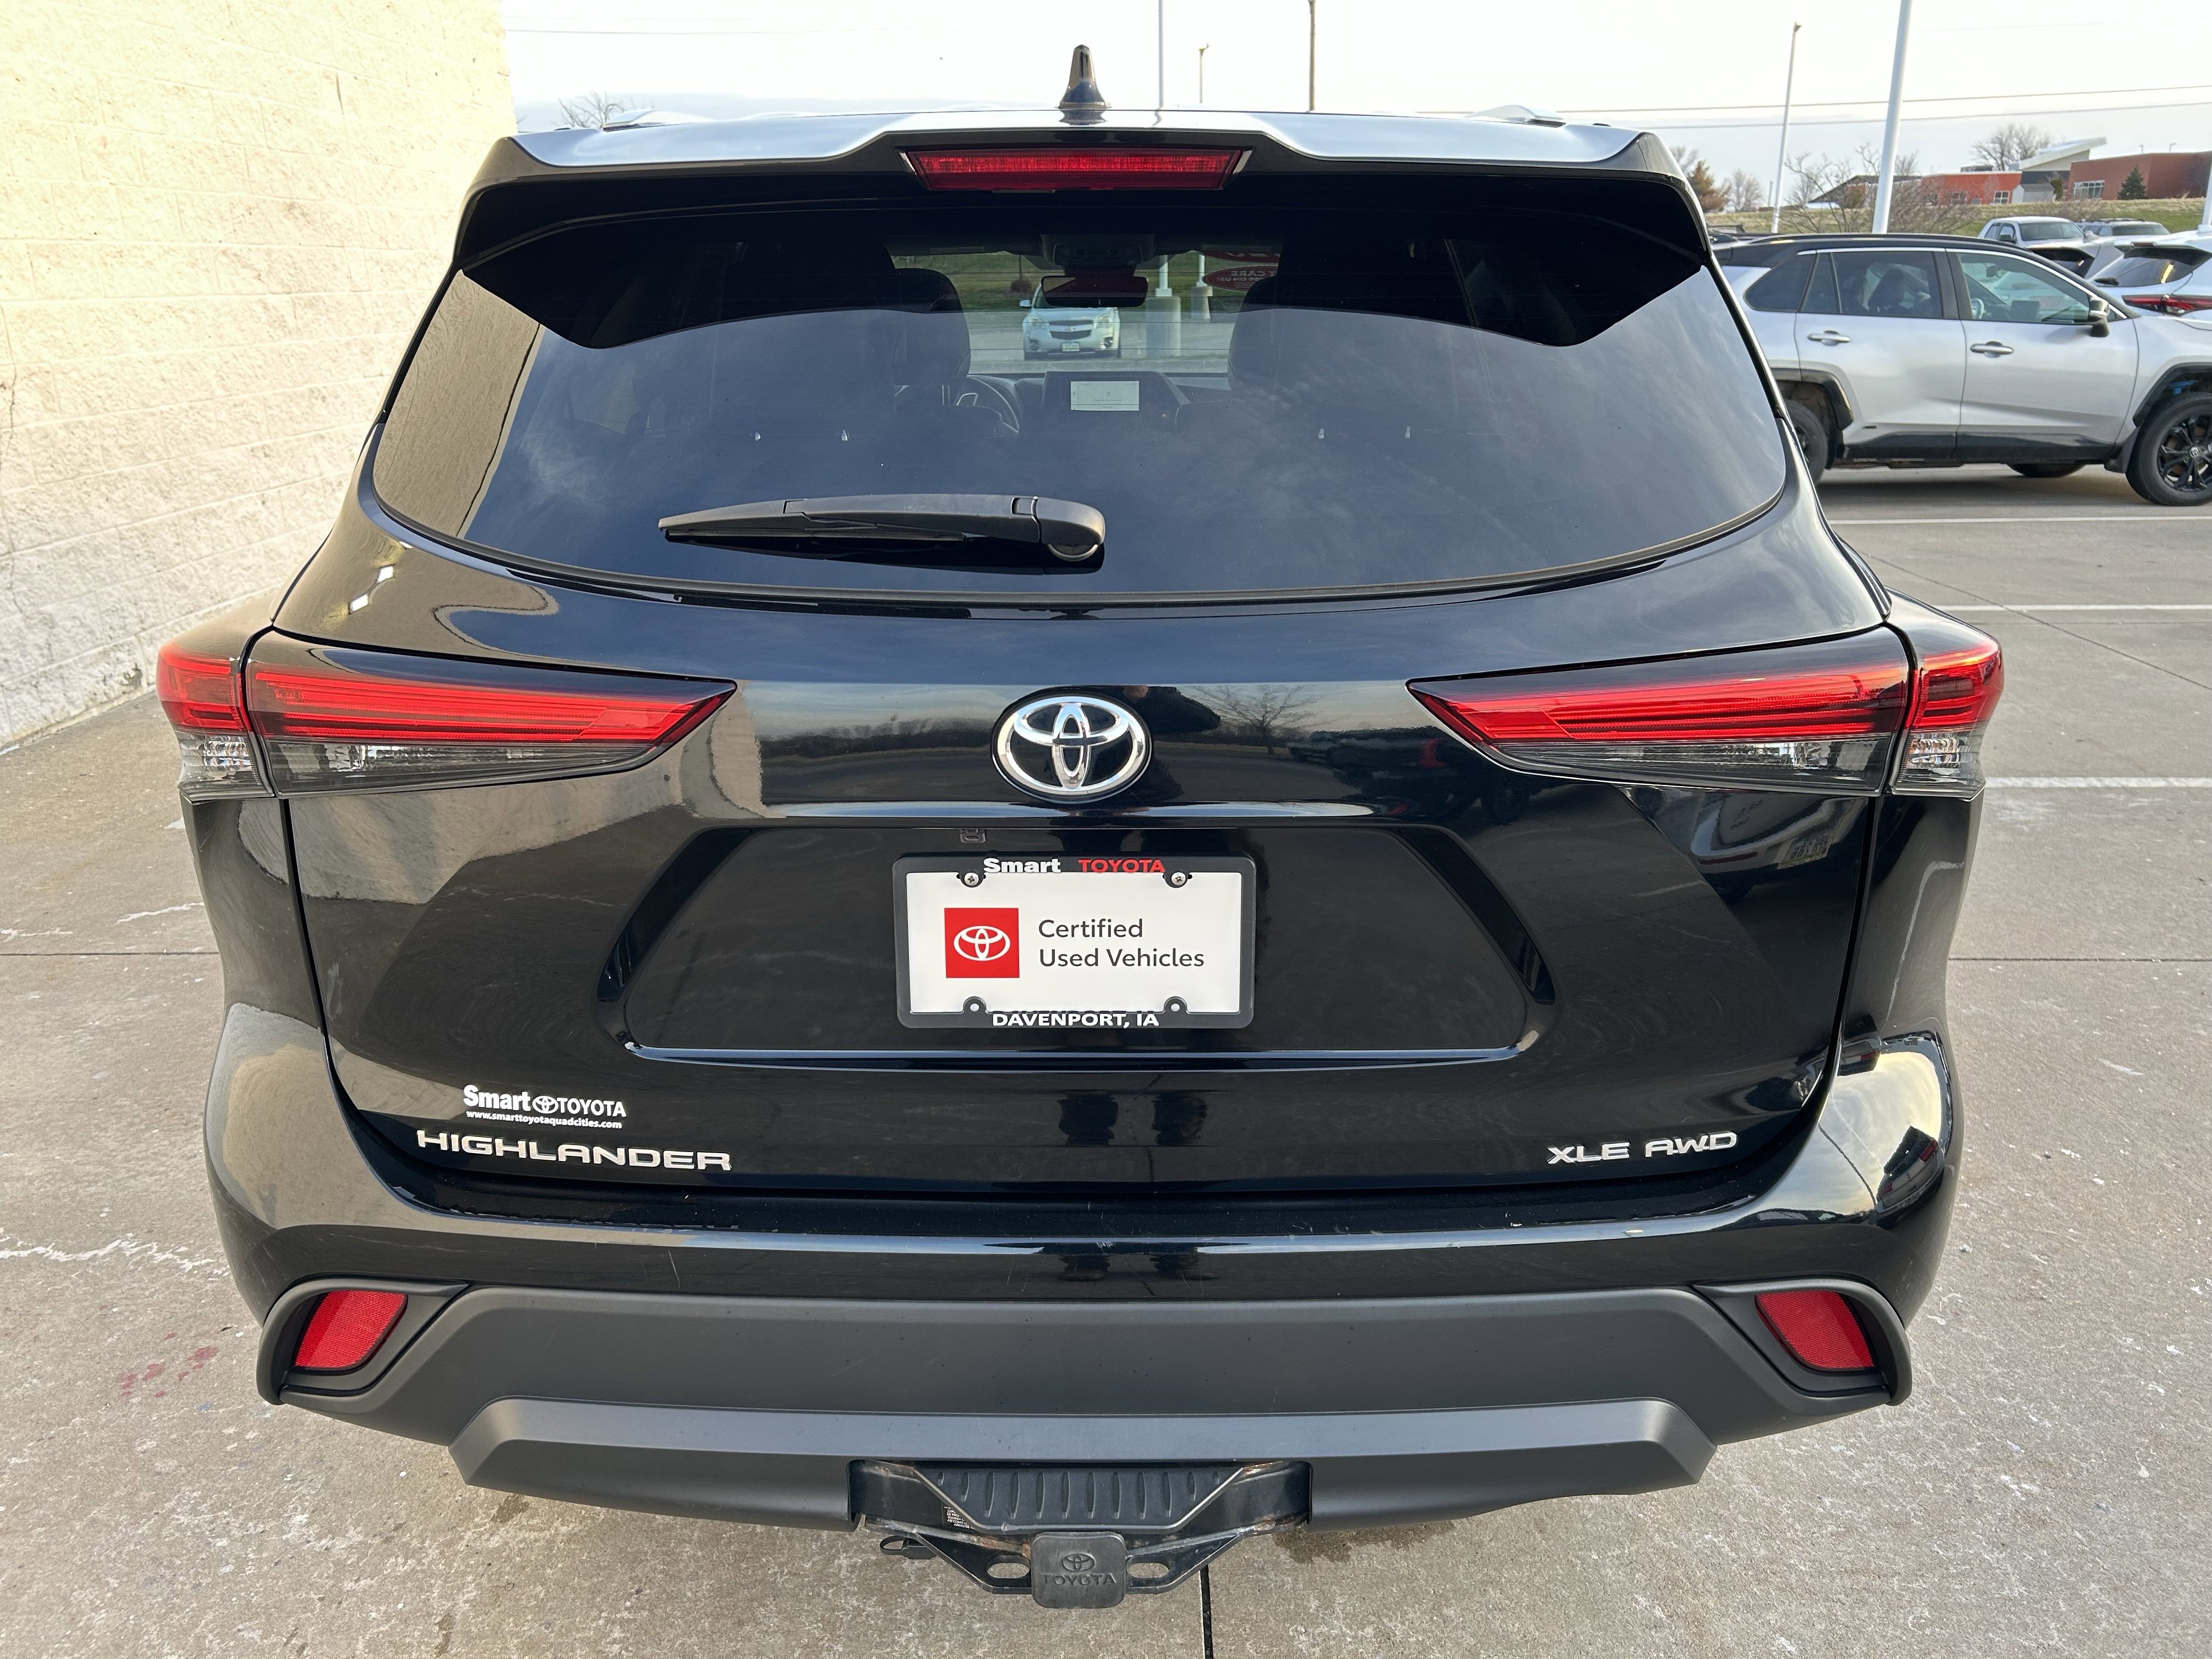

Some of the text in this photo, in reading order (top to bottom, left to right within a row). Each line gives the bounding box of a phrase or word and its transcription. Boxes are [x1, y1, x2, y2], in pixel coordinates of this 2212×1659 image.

[983, 858, 1166, 873] Smart TOYOTA
[1039, 918, 1143, 938] Certified
[1039, 948, 1205, 967] Used Vehicles
[992, 1013, 1159, 1029] DAVENPORT, IA
[463, 1085, 627, 1117] Smart TOYOTA
[466, 1110, 622, 1129] www.smarttoyotaquadcities.com
[416, 1130, 732, 1171] HIGHLANDER
[1547, 1131, 1738, 1164] XLE AWD
[1043, 1572, 1116, 1585] TOYOTA
